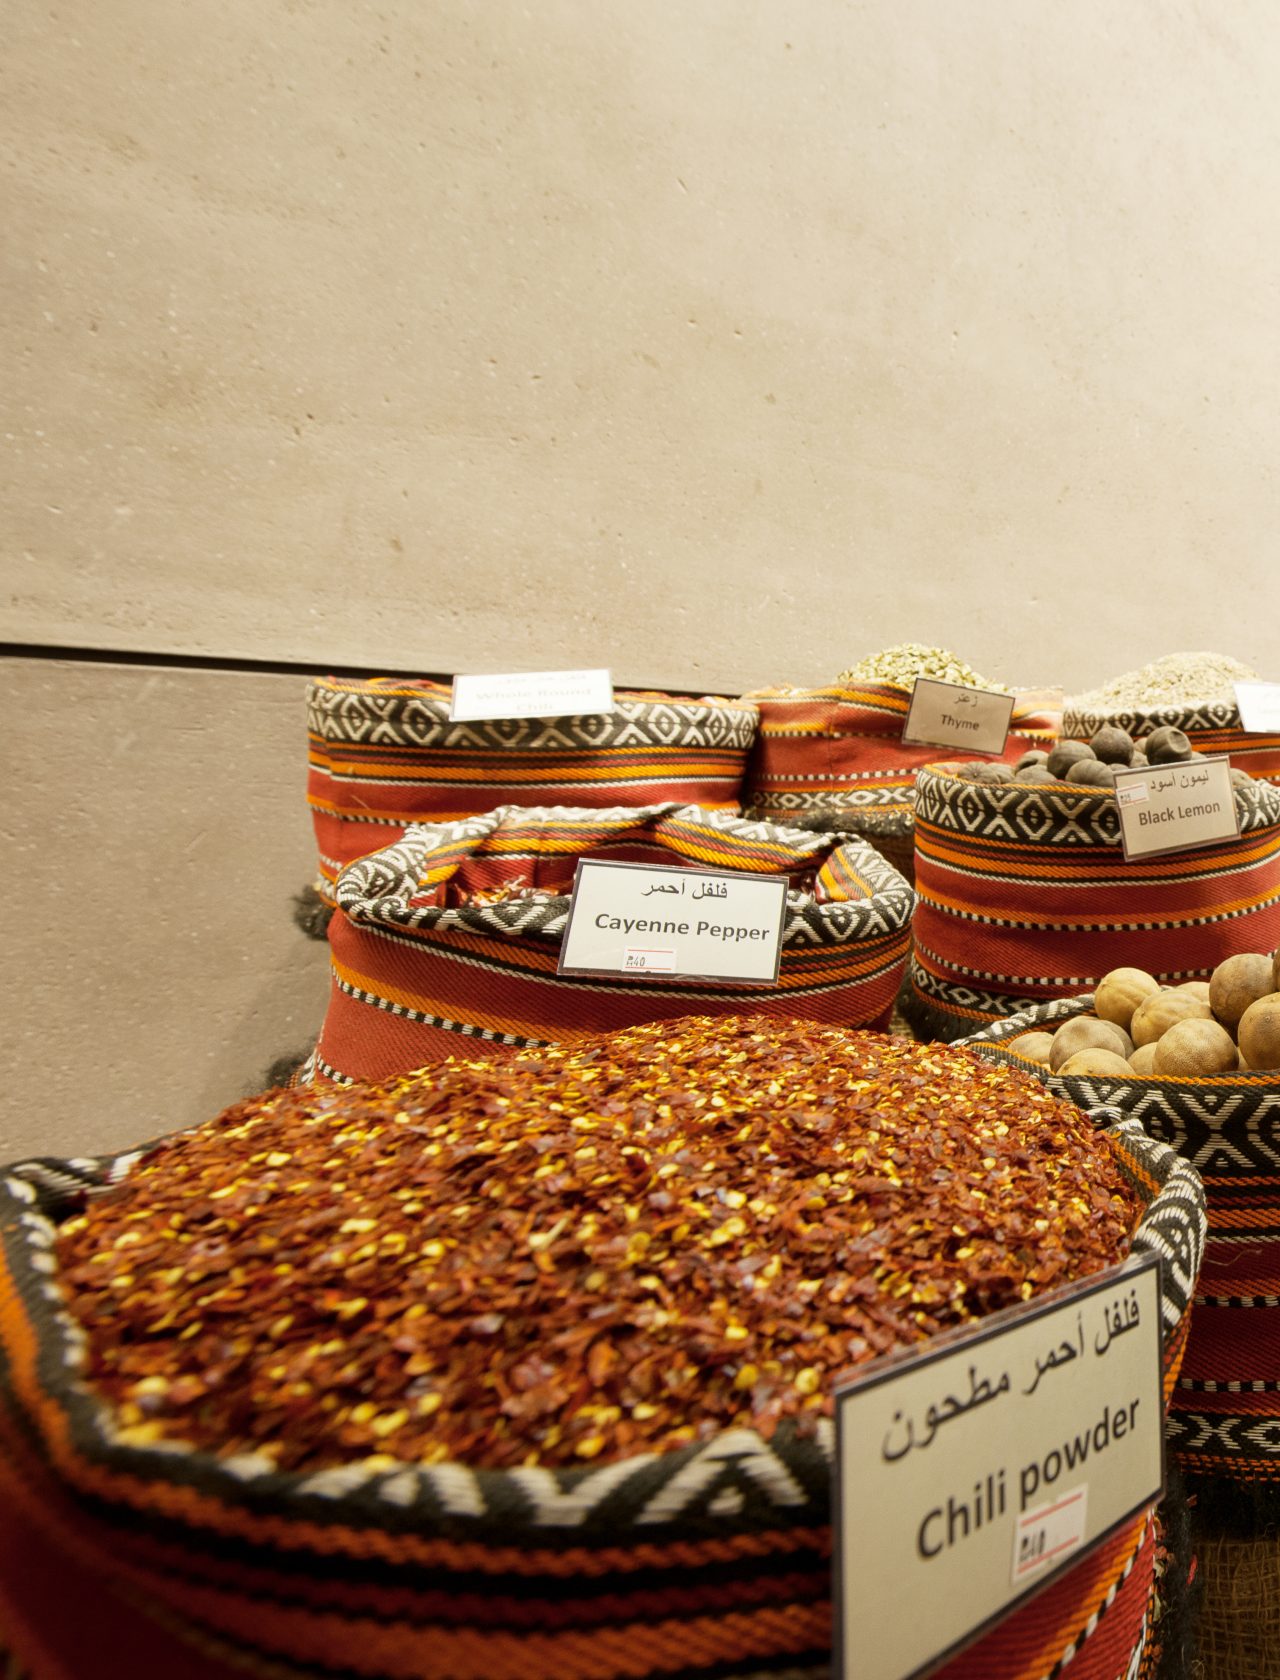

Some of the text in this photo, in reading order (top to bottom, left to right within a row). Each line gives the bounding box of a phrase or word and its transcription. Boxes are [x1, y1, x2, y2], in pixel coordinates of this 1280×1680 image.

[941, 714, 980, 731] Thyme
[1180, 770, 1209, 789] ليمون
[1138, 802, 1221, 827] Black Lemon
[641, 878, 728, 900] فلفل أحمر
[595, 913, 770, 942] Cayenne Pepper
[881, 1288, 1141, 1463] فلفل أحمر مطحون
[917, 1397, 1141, 1560] Chili powder
